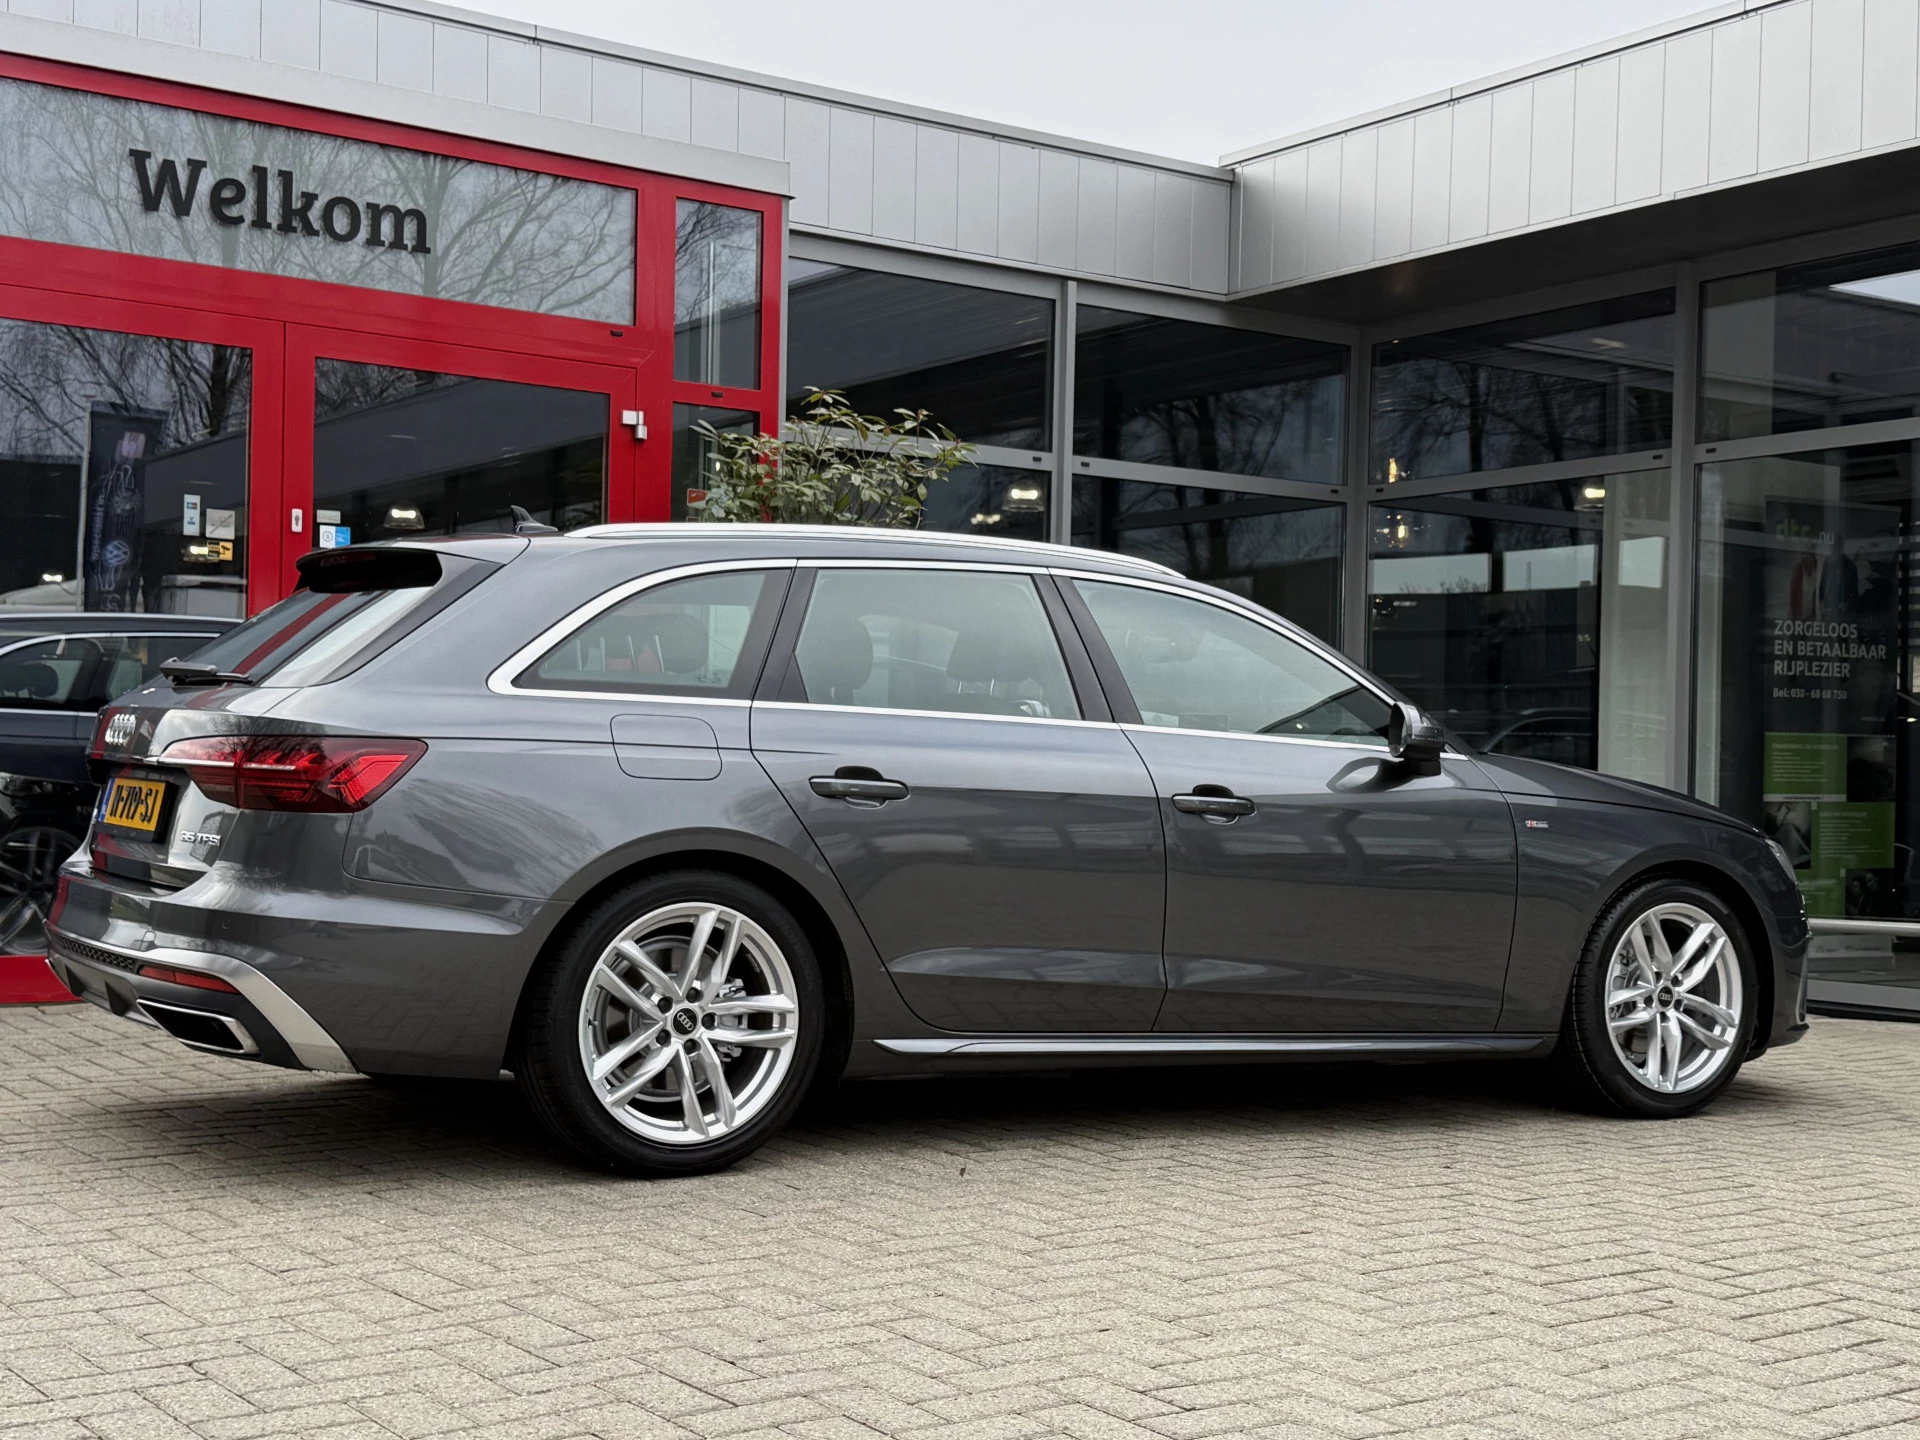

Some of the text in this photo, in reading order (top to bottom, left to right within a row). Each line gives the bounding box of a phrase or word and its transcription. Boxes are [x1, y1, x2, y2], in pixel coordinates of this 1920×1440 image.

[129, 148, 431, 254] Welkom
[1773, 619, 1858, 638] ZORGELOOS
[1773, 640, 1887, 660] EN BETAALBAAR
[1773, 660, 1850, 678] RIJPLEZIER
[1772, 687, 1790, 698] Bel:
